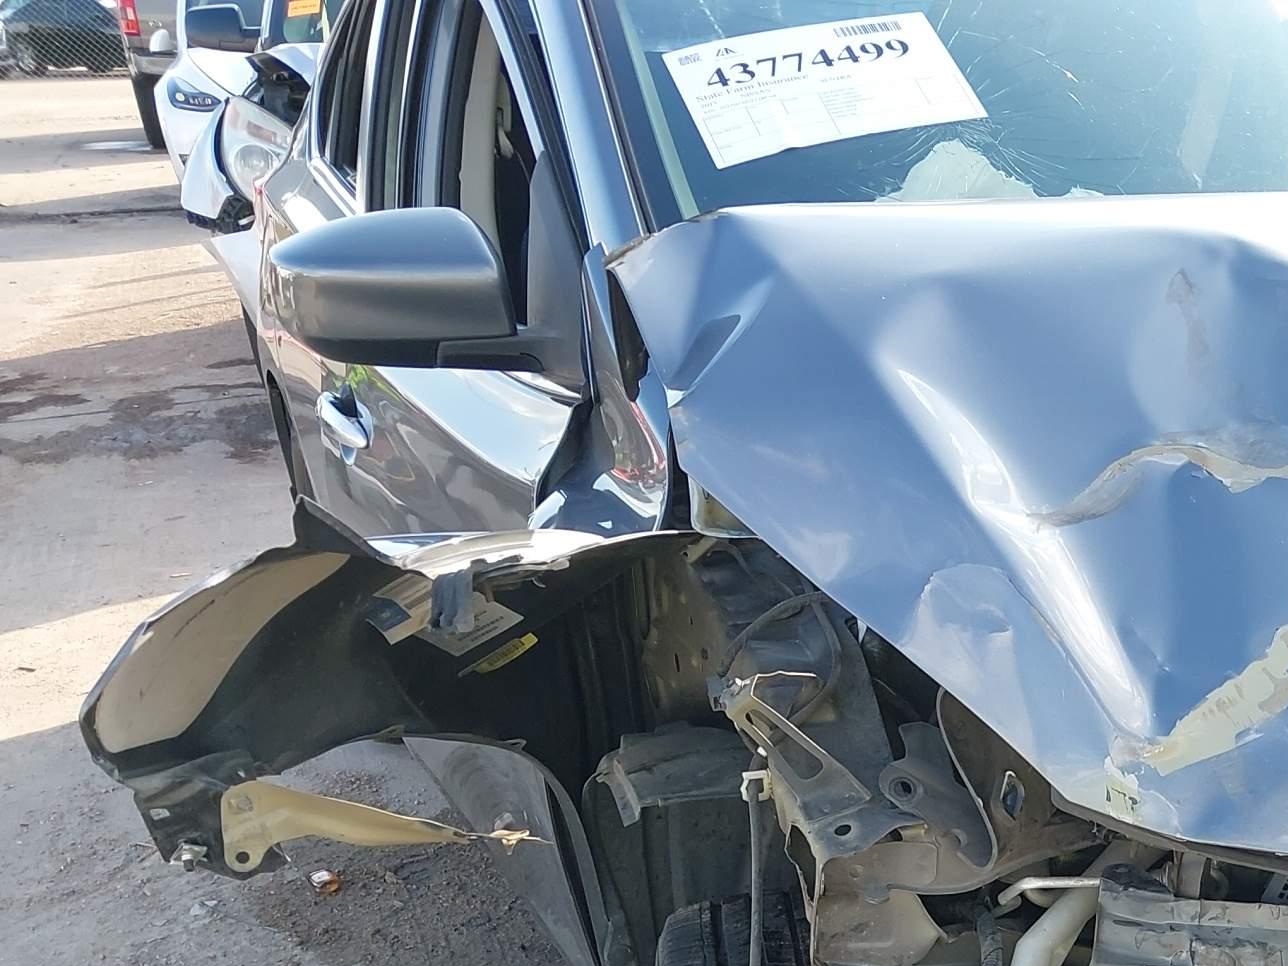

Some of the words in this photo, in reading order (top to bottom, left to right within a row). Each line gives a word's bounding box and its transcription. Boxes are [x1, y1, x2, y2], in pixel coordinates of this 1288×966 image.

[707, 39, 909, 87] 43774499
[696, 91, 724, 103] State
[726, 84, 755, 97] Farm
[757, 74, 809, 88] Insurance
